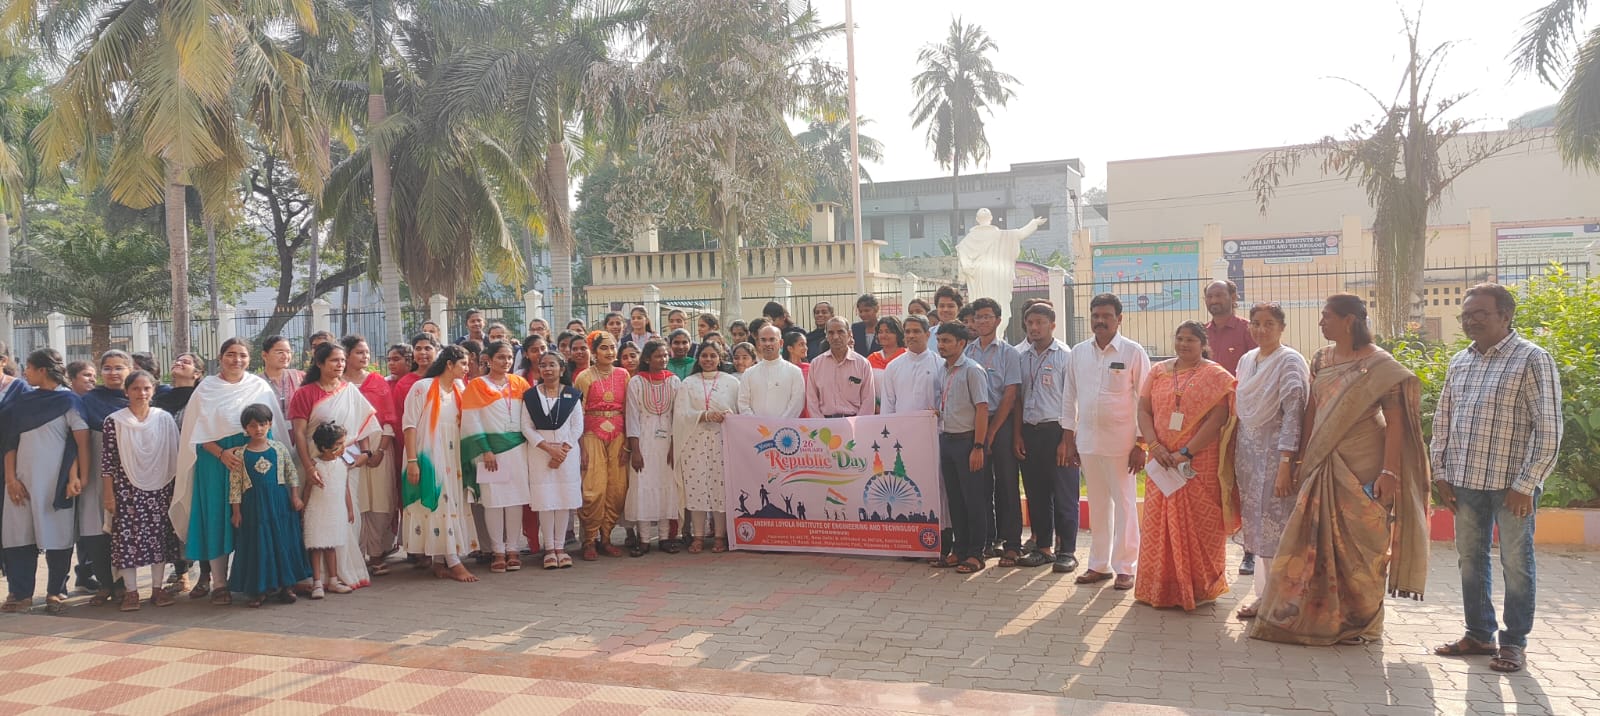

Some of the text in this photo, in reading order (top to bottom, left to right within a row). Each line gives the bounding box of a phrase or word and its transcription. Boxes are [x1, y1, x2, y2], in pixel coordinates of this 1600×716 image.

[765, 451, 867, 471] Republic Day
[753, 520, 775, 528] ANDHRA
[796, 521, 823, 529] INSTITUTE
[831, 522, 868, 531] ENGINEERING
[882, 524, 920, 533] TECHNOLOGY
